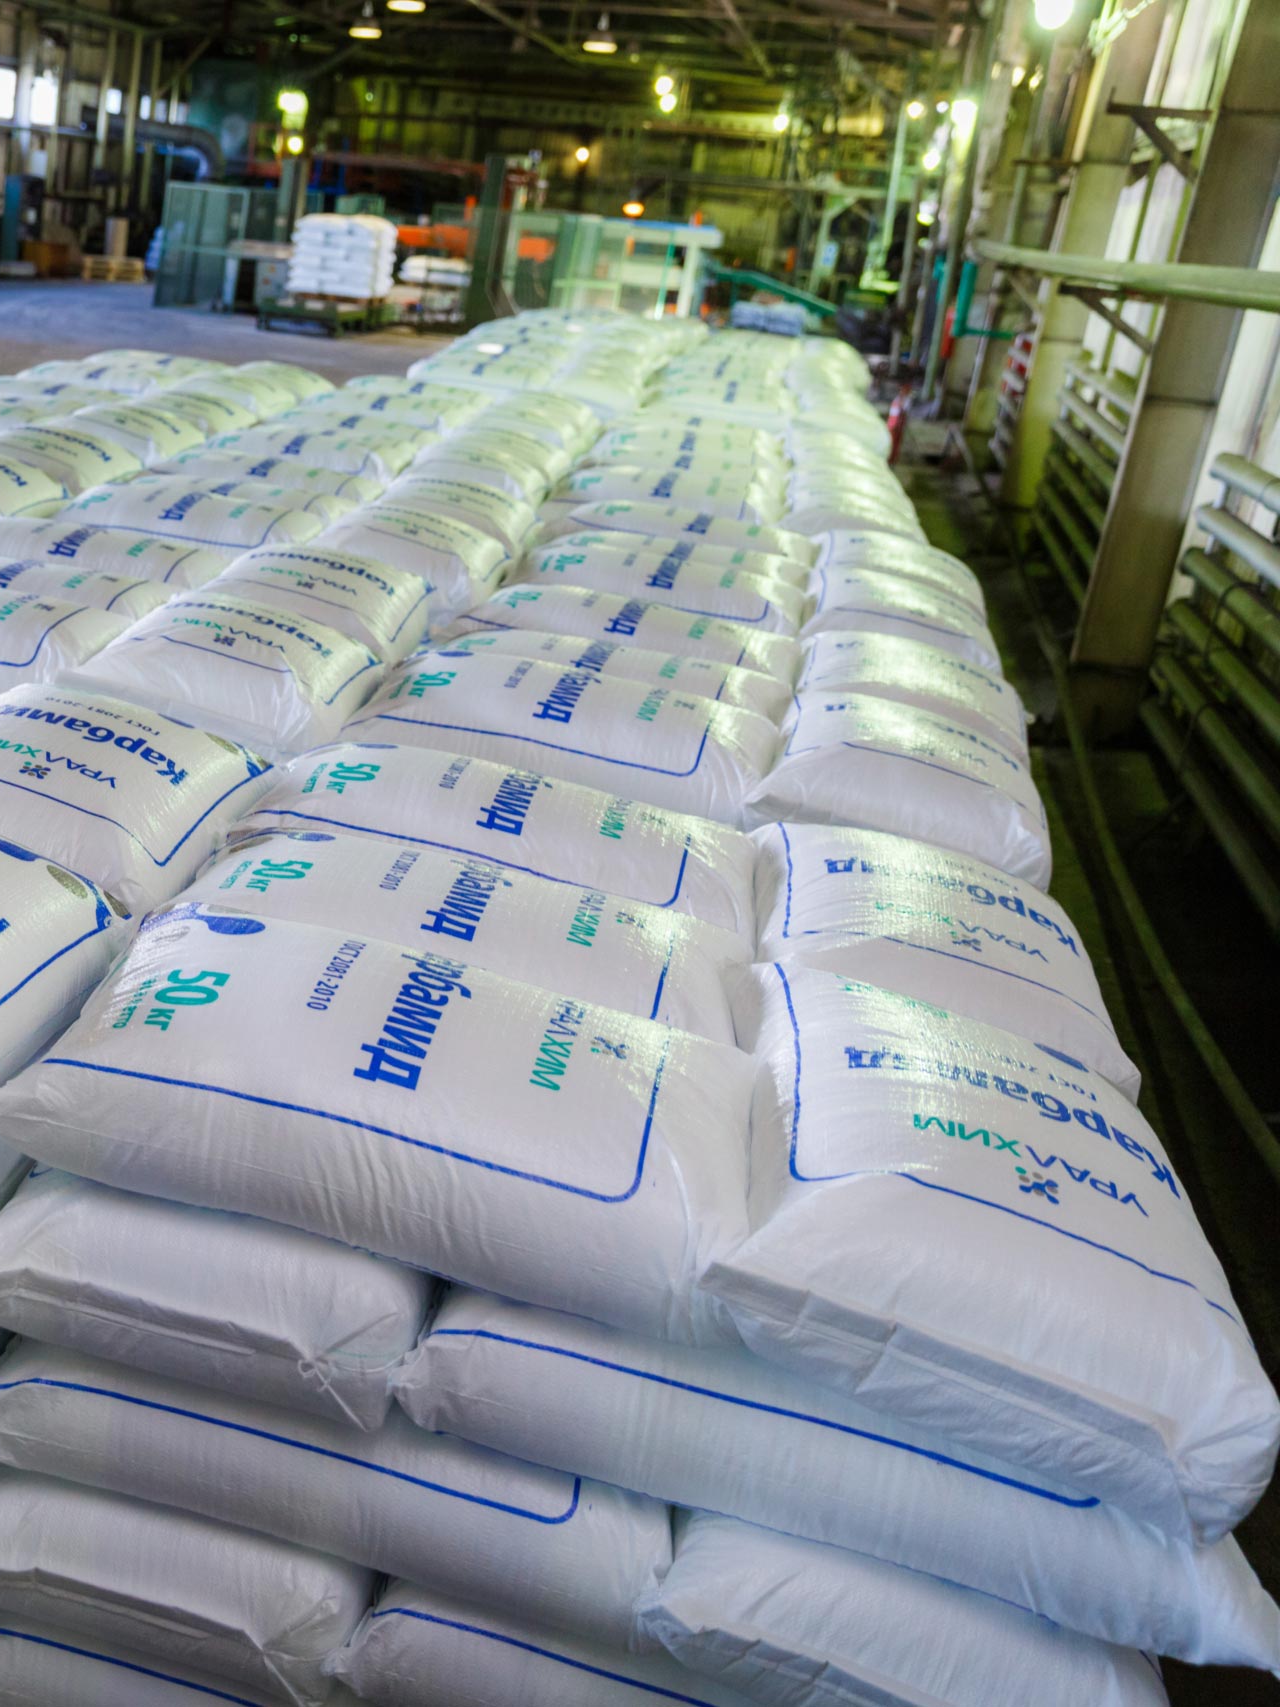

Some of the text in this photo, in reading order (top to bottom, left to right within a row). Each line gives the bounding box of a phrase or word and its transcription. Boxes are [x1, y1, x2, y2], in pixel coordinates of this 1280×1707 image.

[125, 719, 161, 736] ГОСТ
[326, 761, 382, 794] 50 кг
[246, 859, 314, 892] 50 кг
[154, 968, 231, 1006] 50
[306, 939, 367, 1011] ГОСТ 2081-2010
[144, 1007, 176, 1031] кг
[913, 1113, 1150, 1218] УРАЛХИМ
